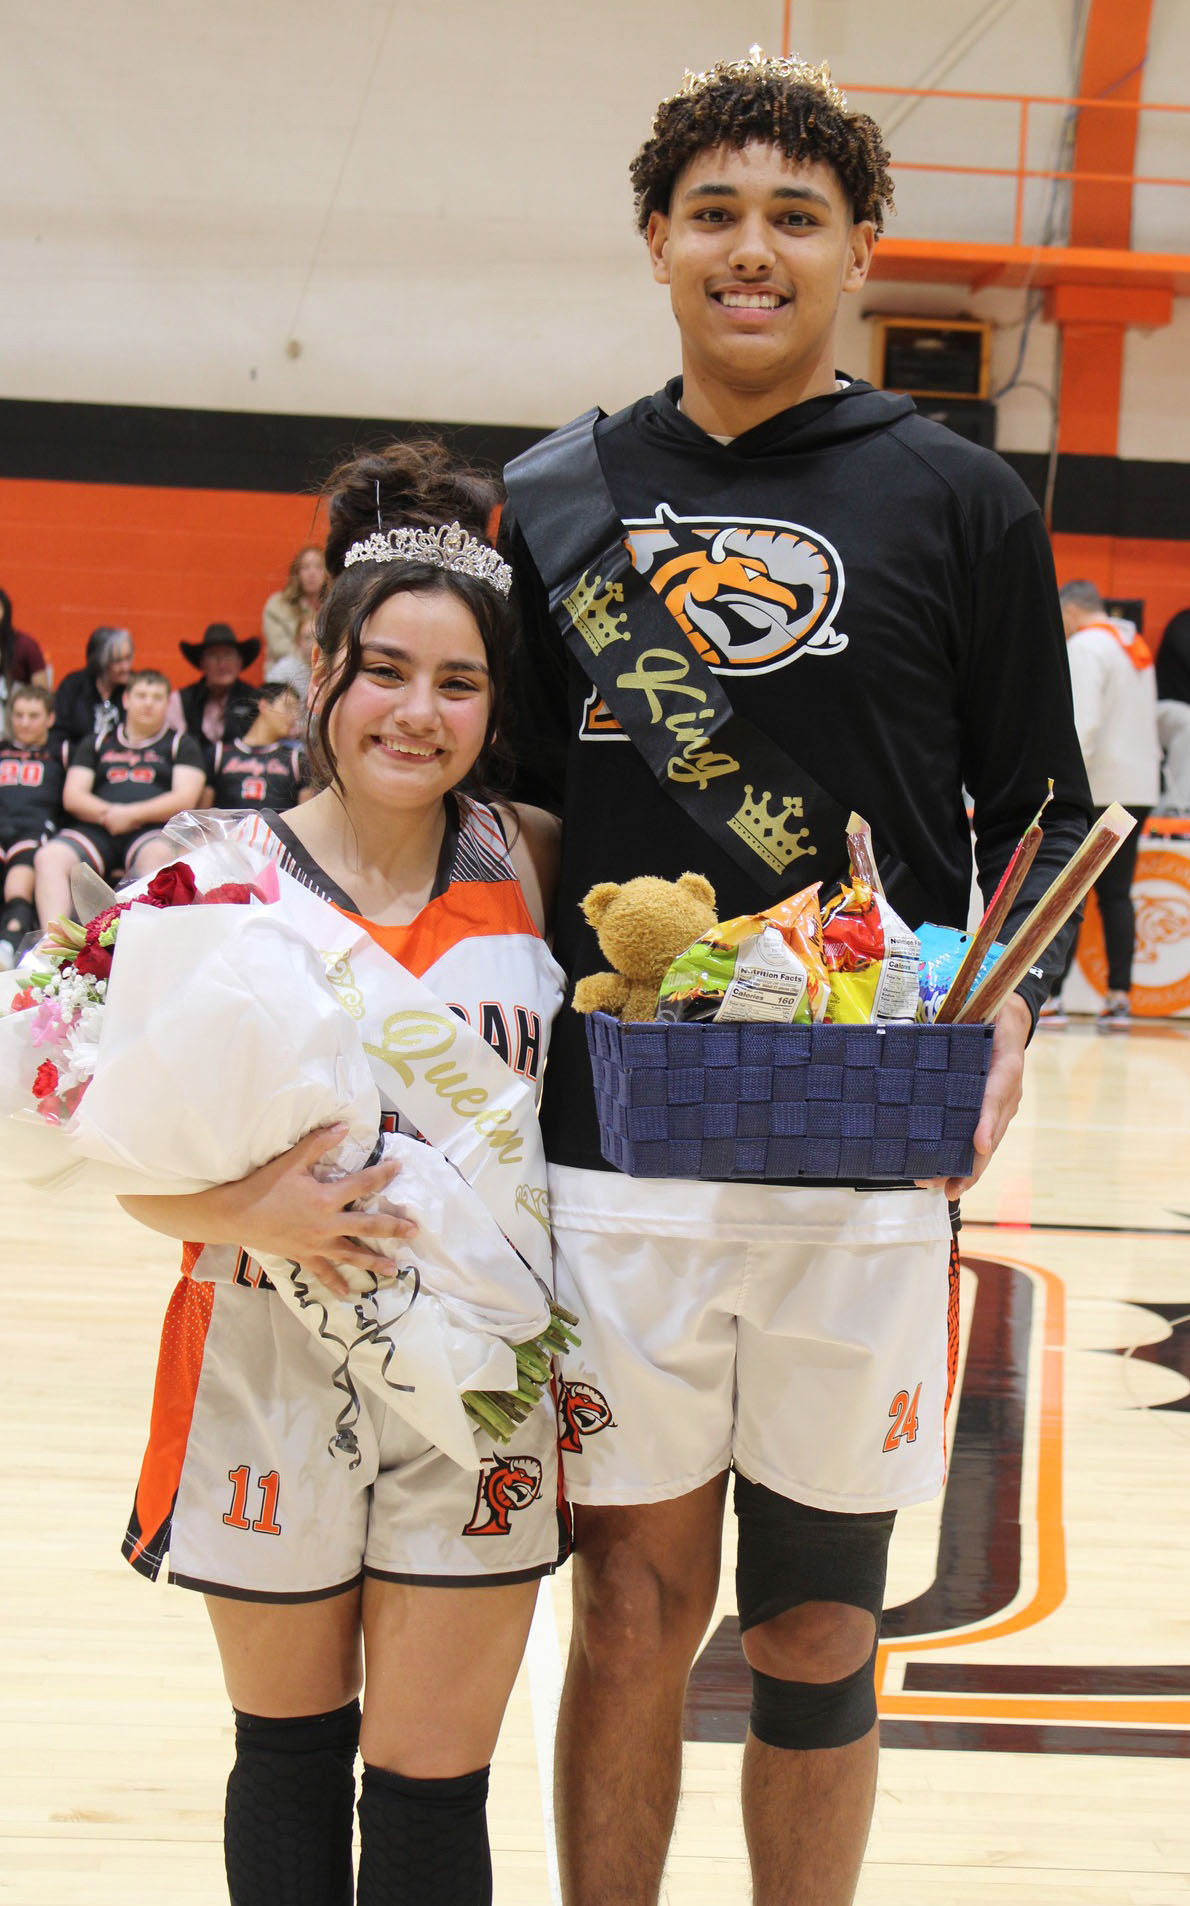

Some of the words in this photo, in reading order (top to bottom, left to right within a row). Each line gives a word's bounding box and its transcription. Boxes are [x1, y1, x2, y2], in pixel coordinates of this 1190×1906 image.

[616, 648, 740, 790] King
[733, 988, 764, 1001] Calories
[777, 997, 795, 1005] 160
[780, 973, 803, 982] Facts
[362, 1010, 526, 1165] Queen
[882, 1381, 922, 1453] 24
[223, 1464, 282, 1536] 11
